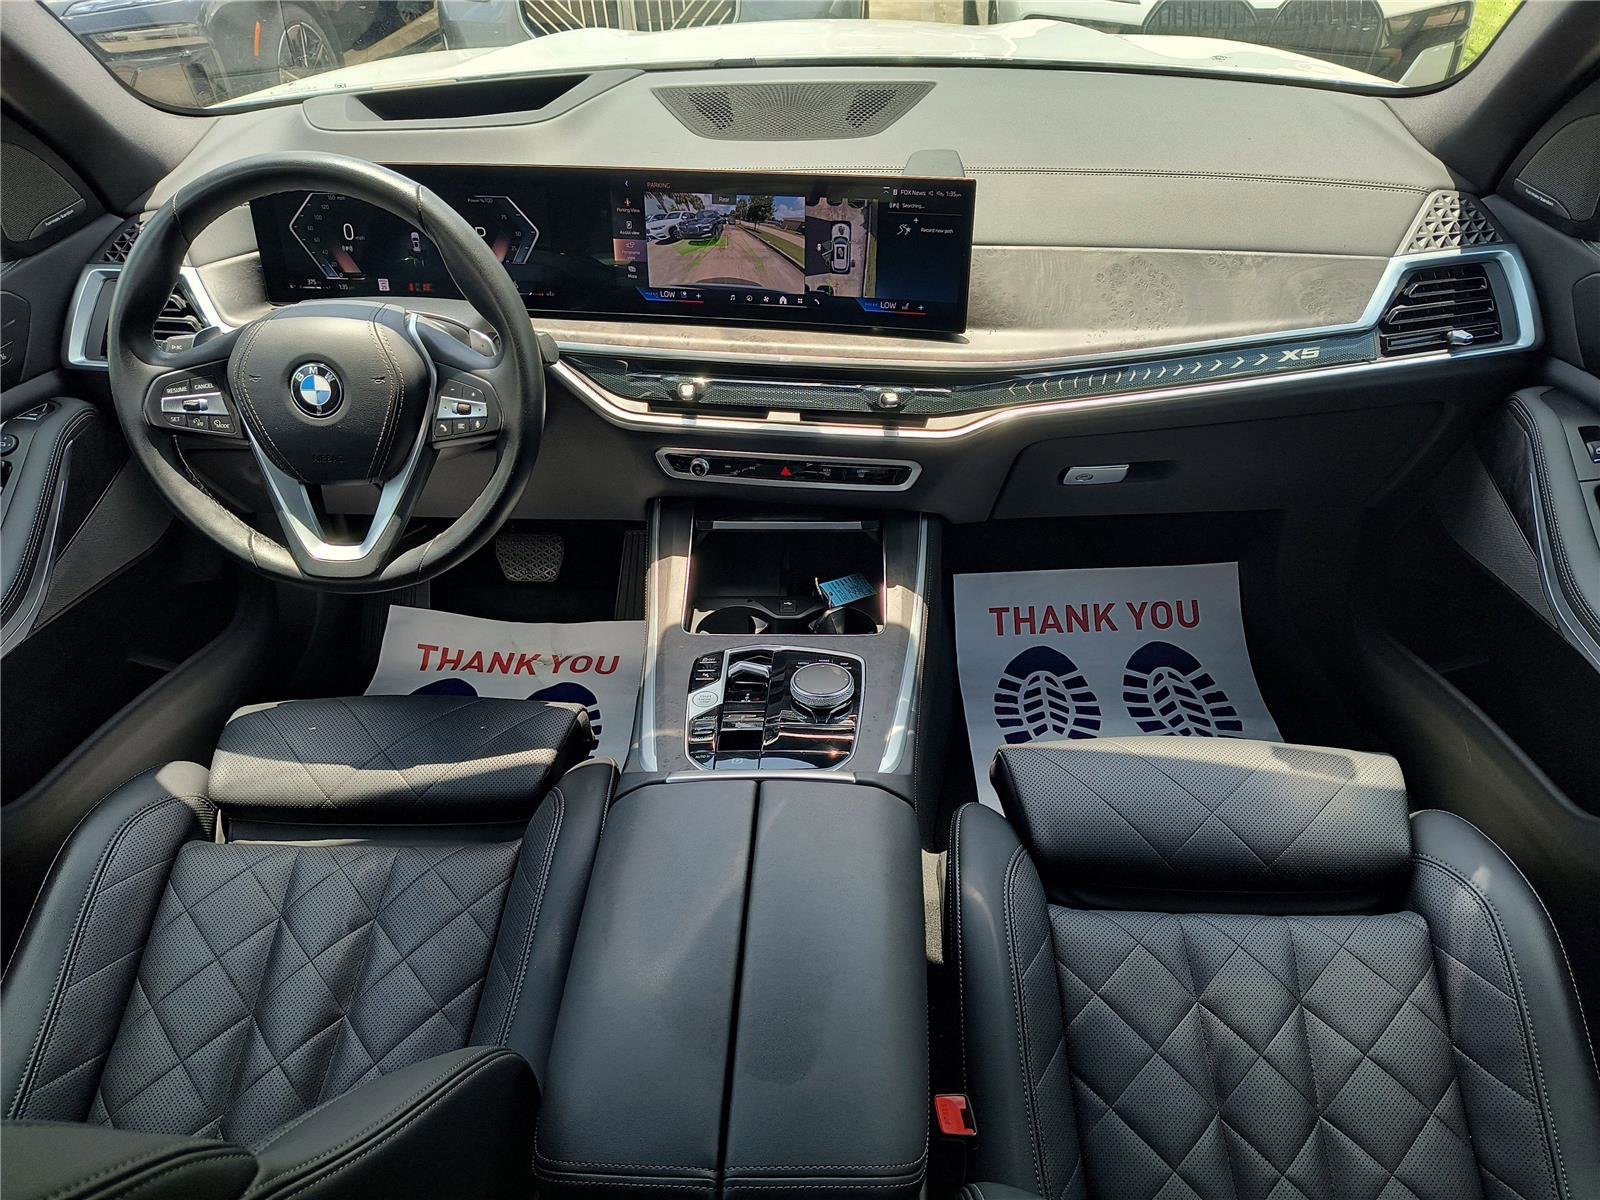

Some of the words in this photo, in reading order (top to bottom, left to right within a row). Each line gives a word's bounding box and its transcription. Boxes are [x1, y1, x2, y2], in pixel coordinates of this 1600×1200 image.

[646, 181, 672, 189] PARKING
[900, 188, 913, 196] FOX
[342, 223, 355, 241] 0
[660, 290, 676, 298] LOW
[880, 301, 897, 309] LOW
[1278, 346, 1320, 362] X5
[295, 366, 336, 382] BMW
[166, 386, 188, 394] RESUME
[194, 382, 214, 390] CANCEL
[988, 602, 1119, 636] THANK
[1126, 599, 1200, 631] YOU
[417, 643, 542, 676] THANK
[551, 654, 620, 675] YOU
